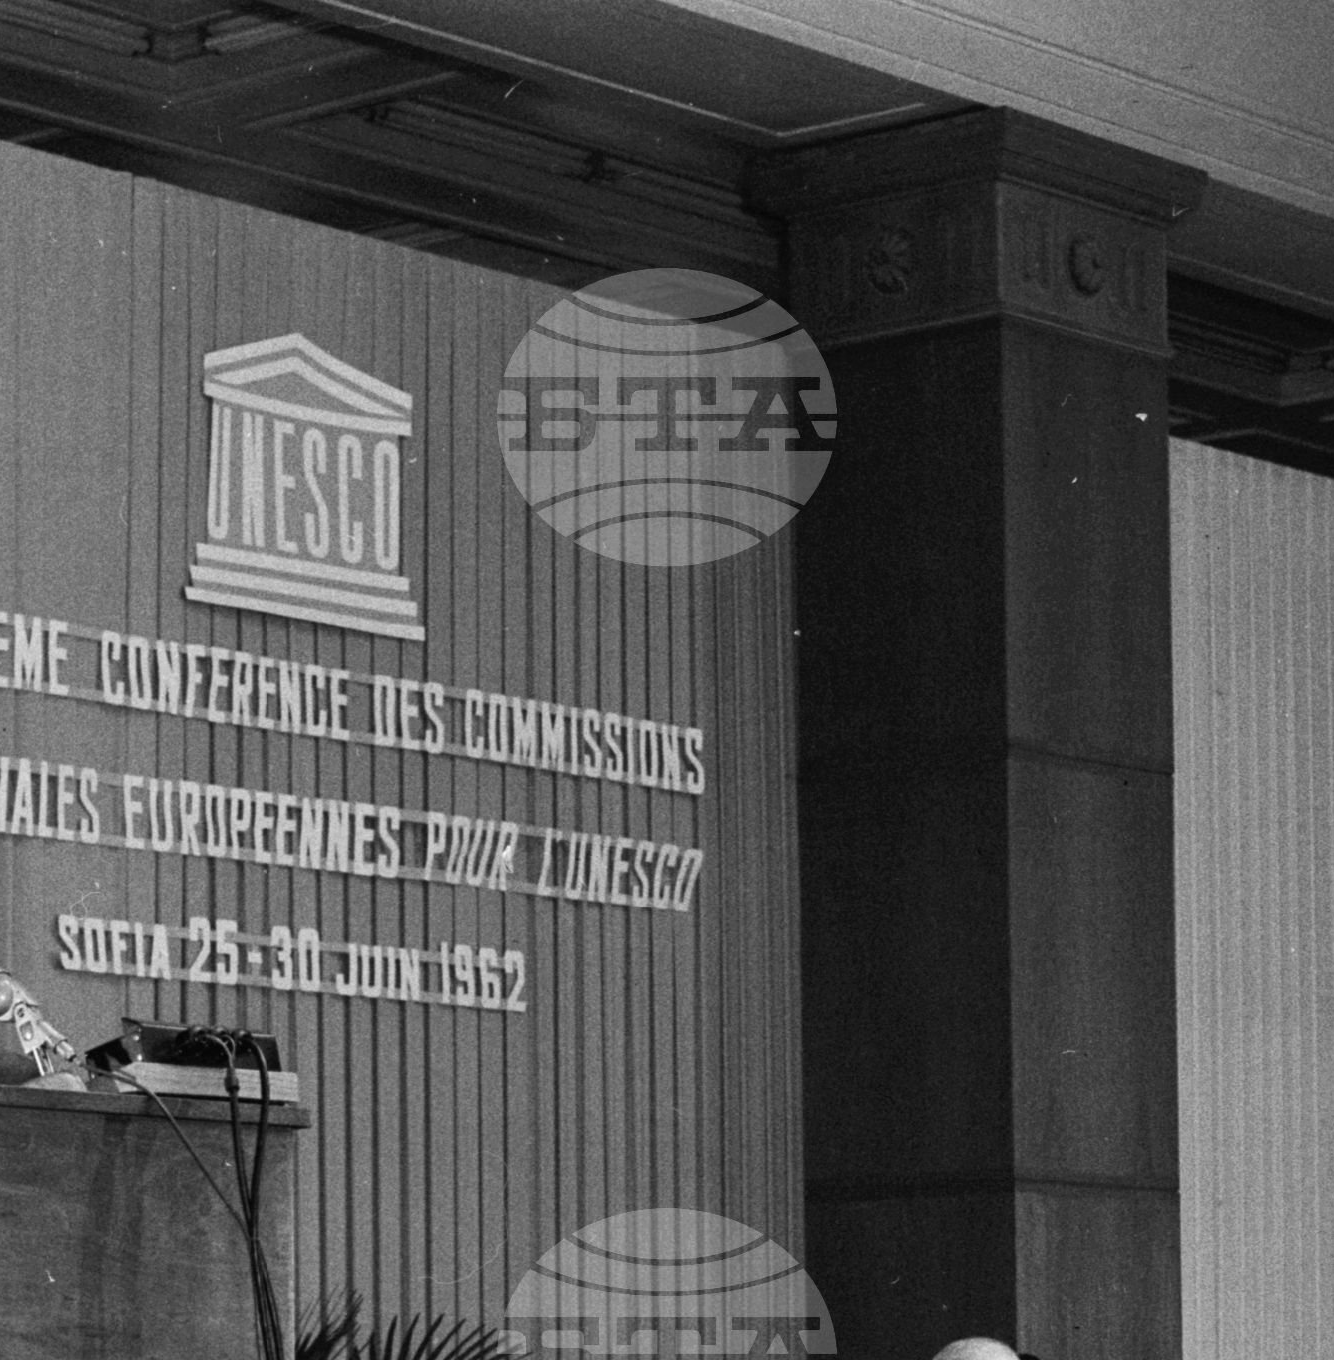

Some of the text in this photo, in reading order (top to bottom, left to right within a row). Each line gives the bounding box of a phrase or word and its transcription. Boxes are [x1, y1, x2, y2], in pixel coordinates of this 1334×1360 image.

[207, 399, 401, 572] UNESCO
[100, 629, 350, 740] CONFERENCE
[373, 674, 445, 754] DES
[465, 688, 705, 795] COMMISSIONS
[122, 773, 401, 878] EUROPEENNES
[425, 810, 518, 892] POUR
[536, 827, 704, 911] L'UNESCO
[58, 914, 171, 980] SOFIA
[336, 942, 420, 1001] JUIN
[440, 941, 527, 1012] 1962
